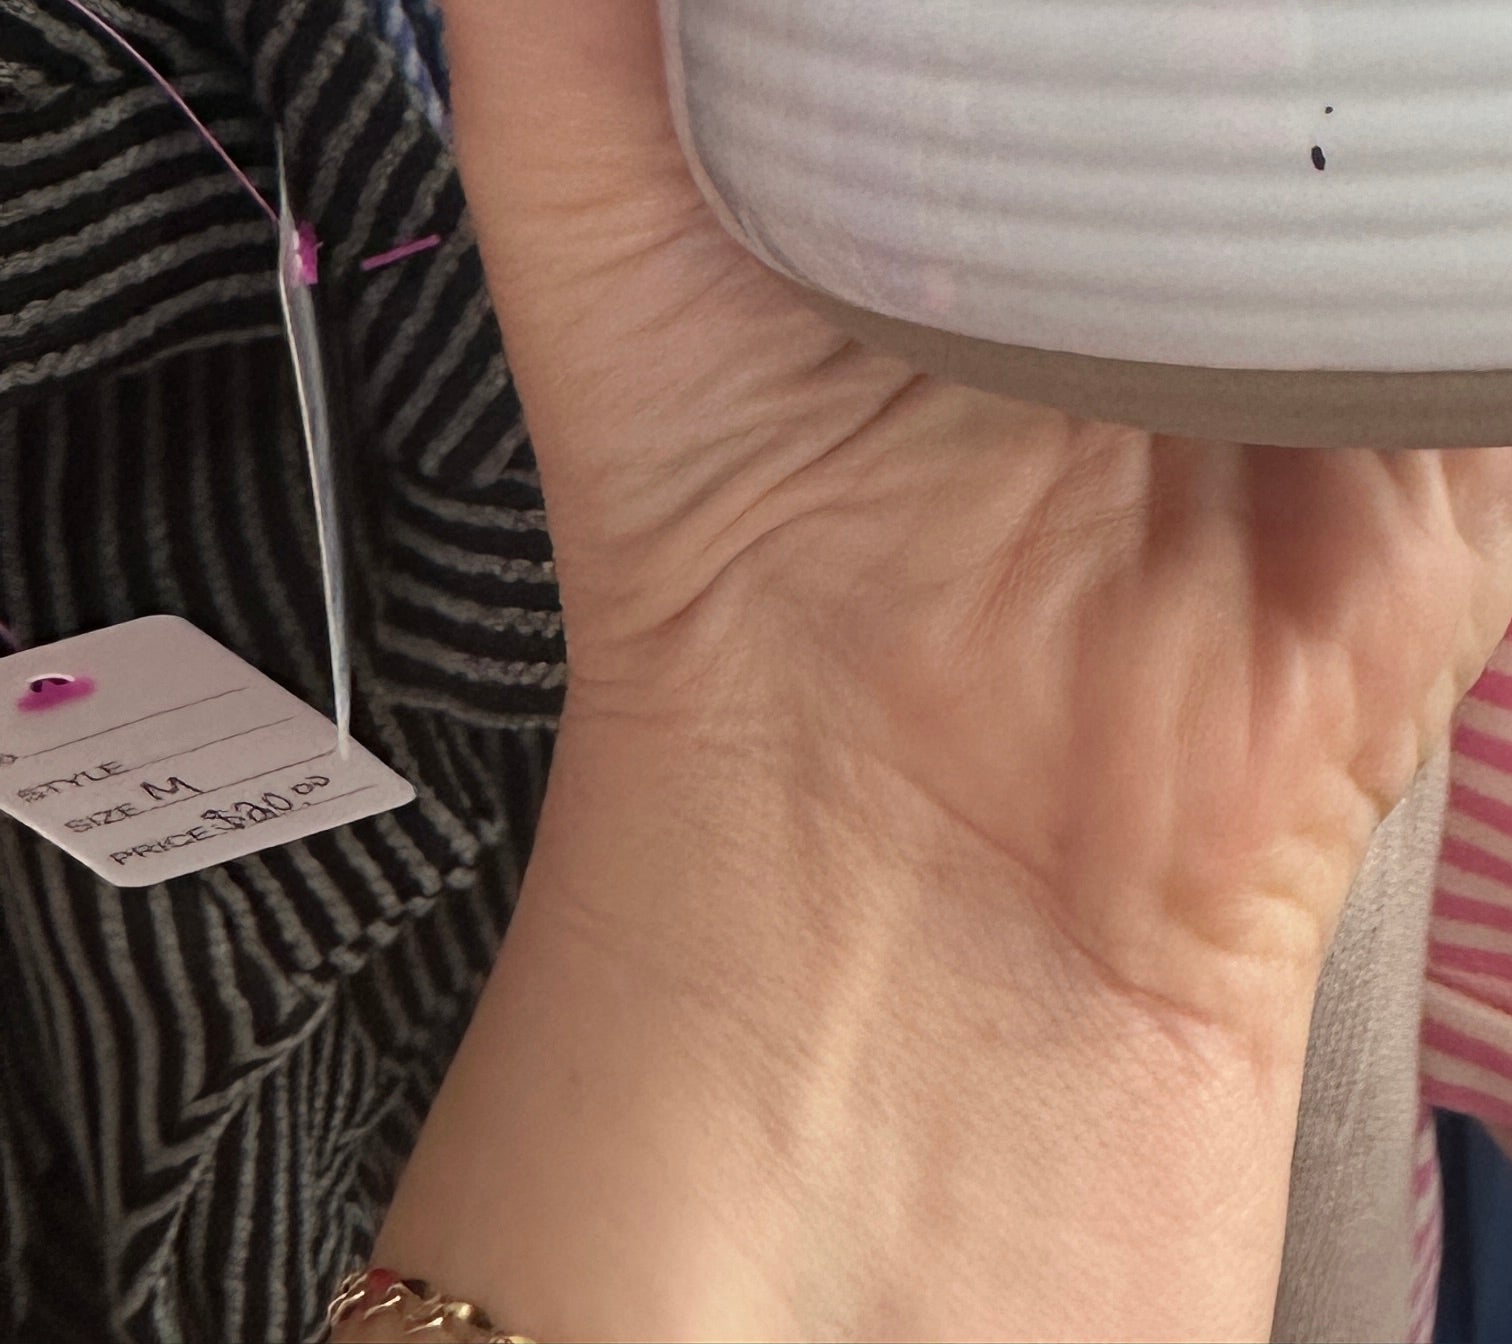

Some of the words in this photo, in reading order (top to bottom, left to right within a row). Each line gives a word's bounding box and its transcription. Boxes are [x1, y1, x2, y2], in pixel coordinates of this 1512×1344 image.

[17, 760, 125, 804] STYLE
[64, 802, 138, 833] SIZE
[140, 775, 202, 801] M
[109, 825, 217, 866] PRICE
